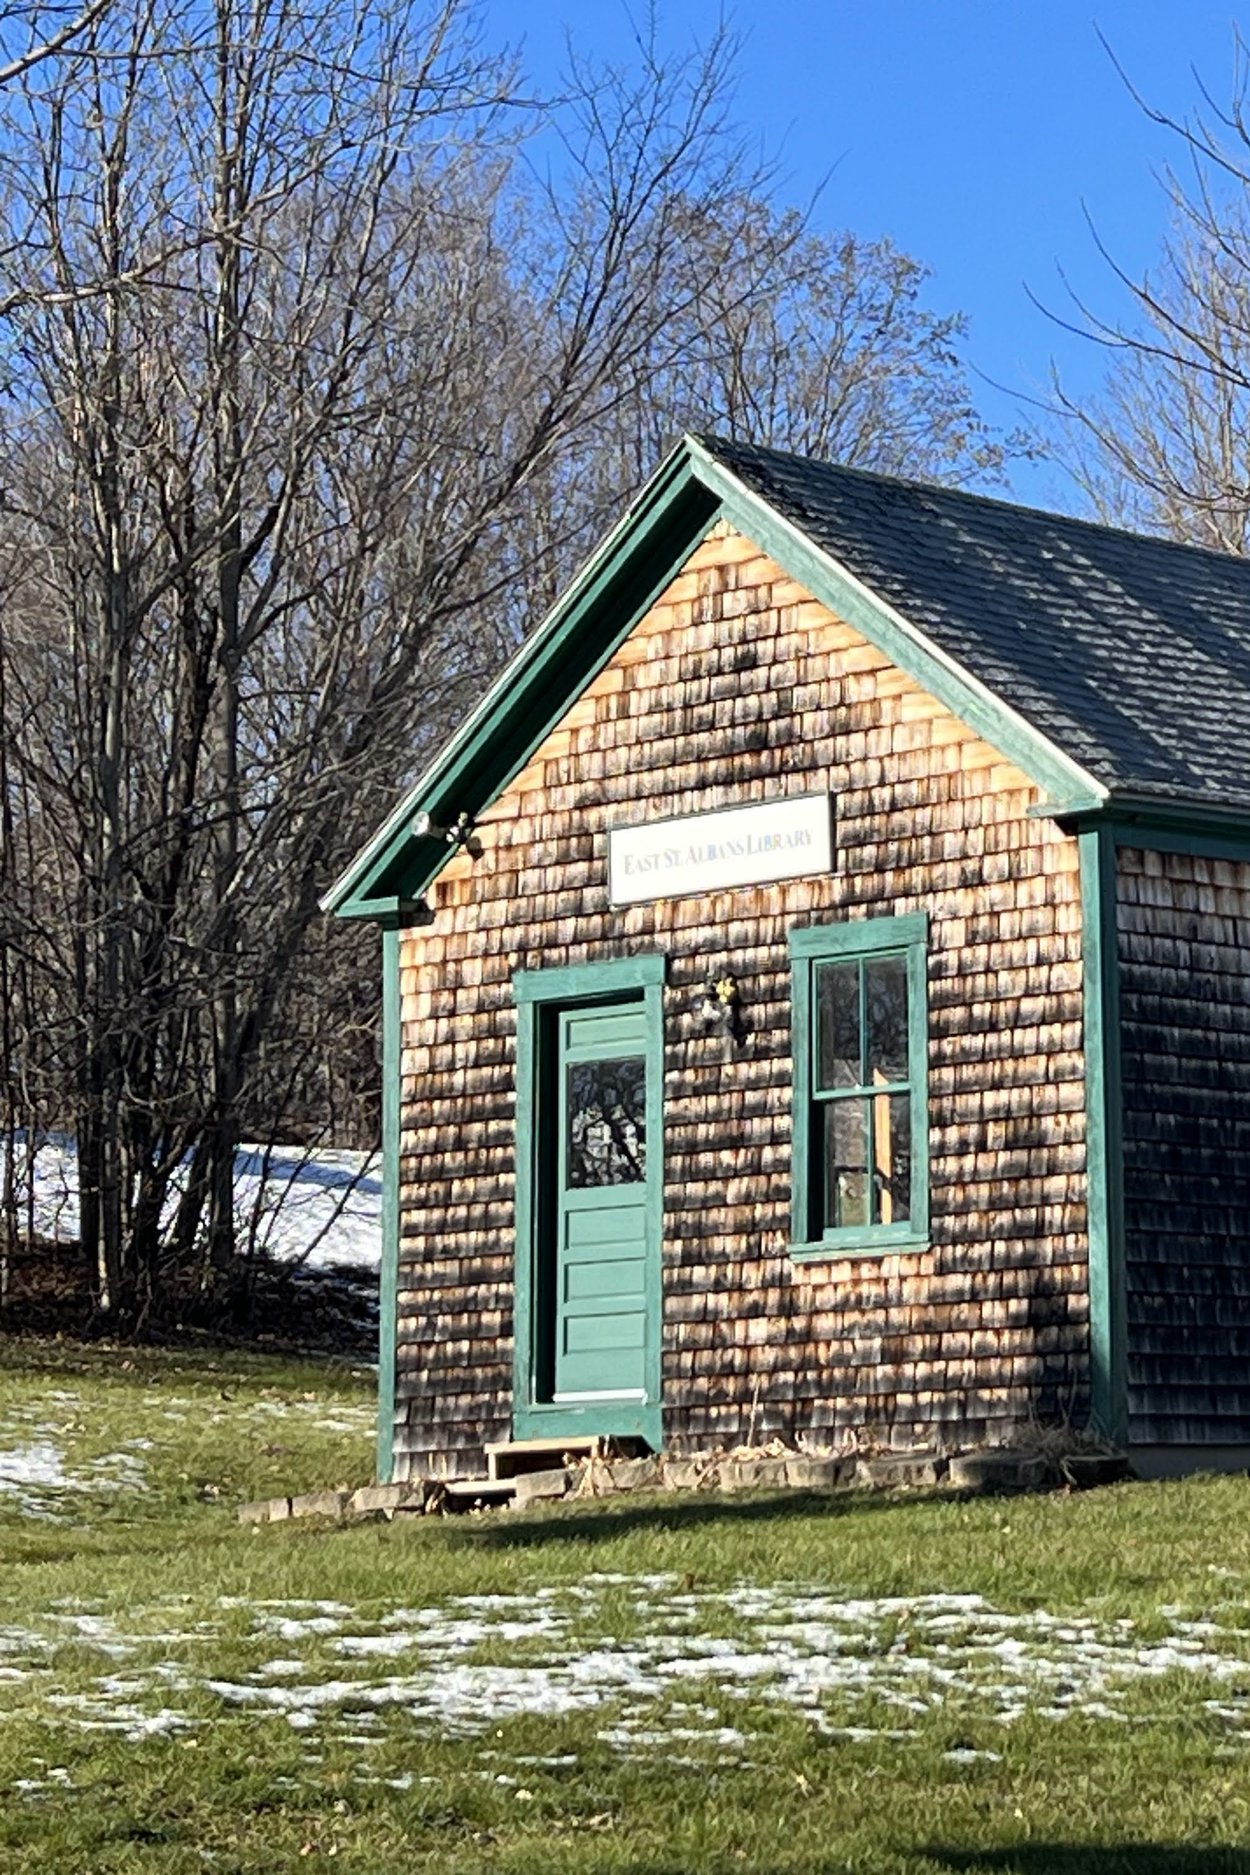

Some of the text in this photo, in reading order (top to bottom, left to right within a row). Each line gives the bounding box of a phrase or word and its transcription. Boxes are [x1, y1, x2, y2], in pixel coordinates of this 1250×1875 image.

[623, 853, 660, 876] EAST
[686, 840, 745, 865] ALBANS
[745, 828, 813, 856] LIBRARY
